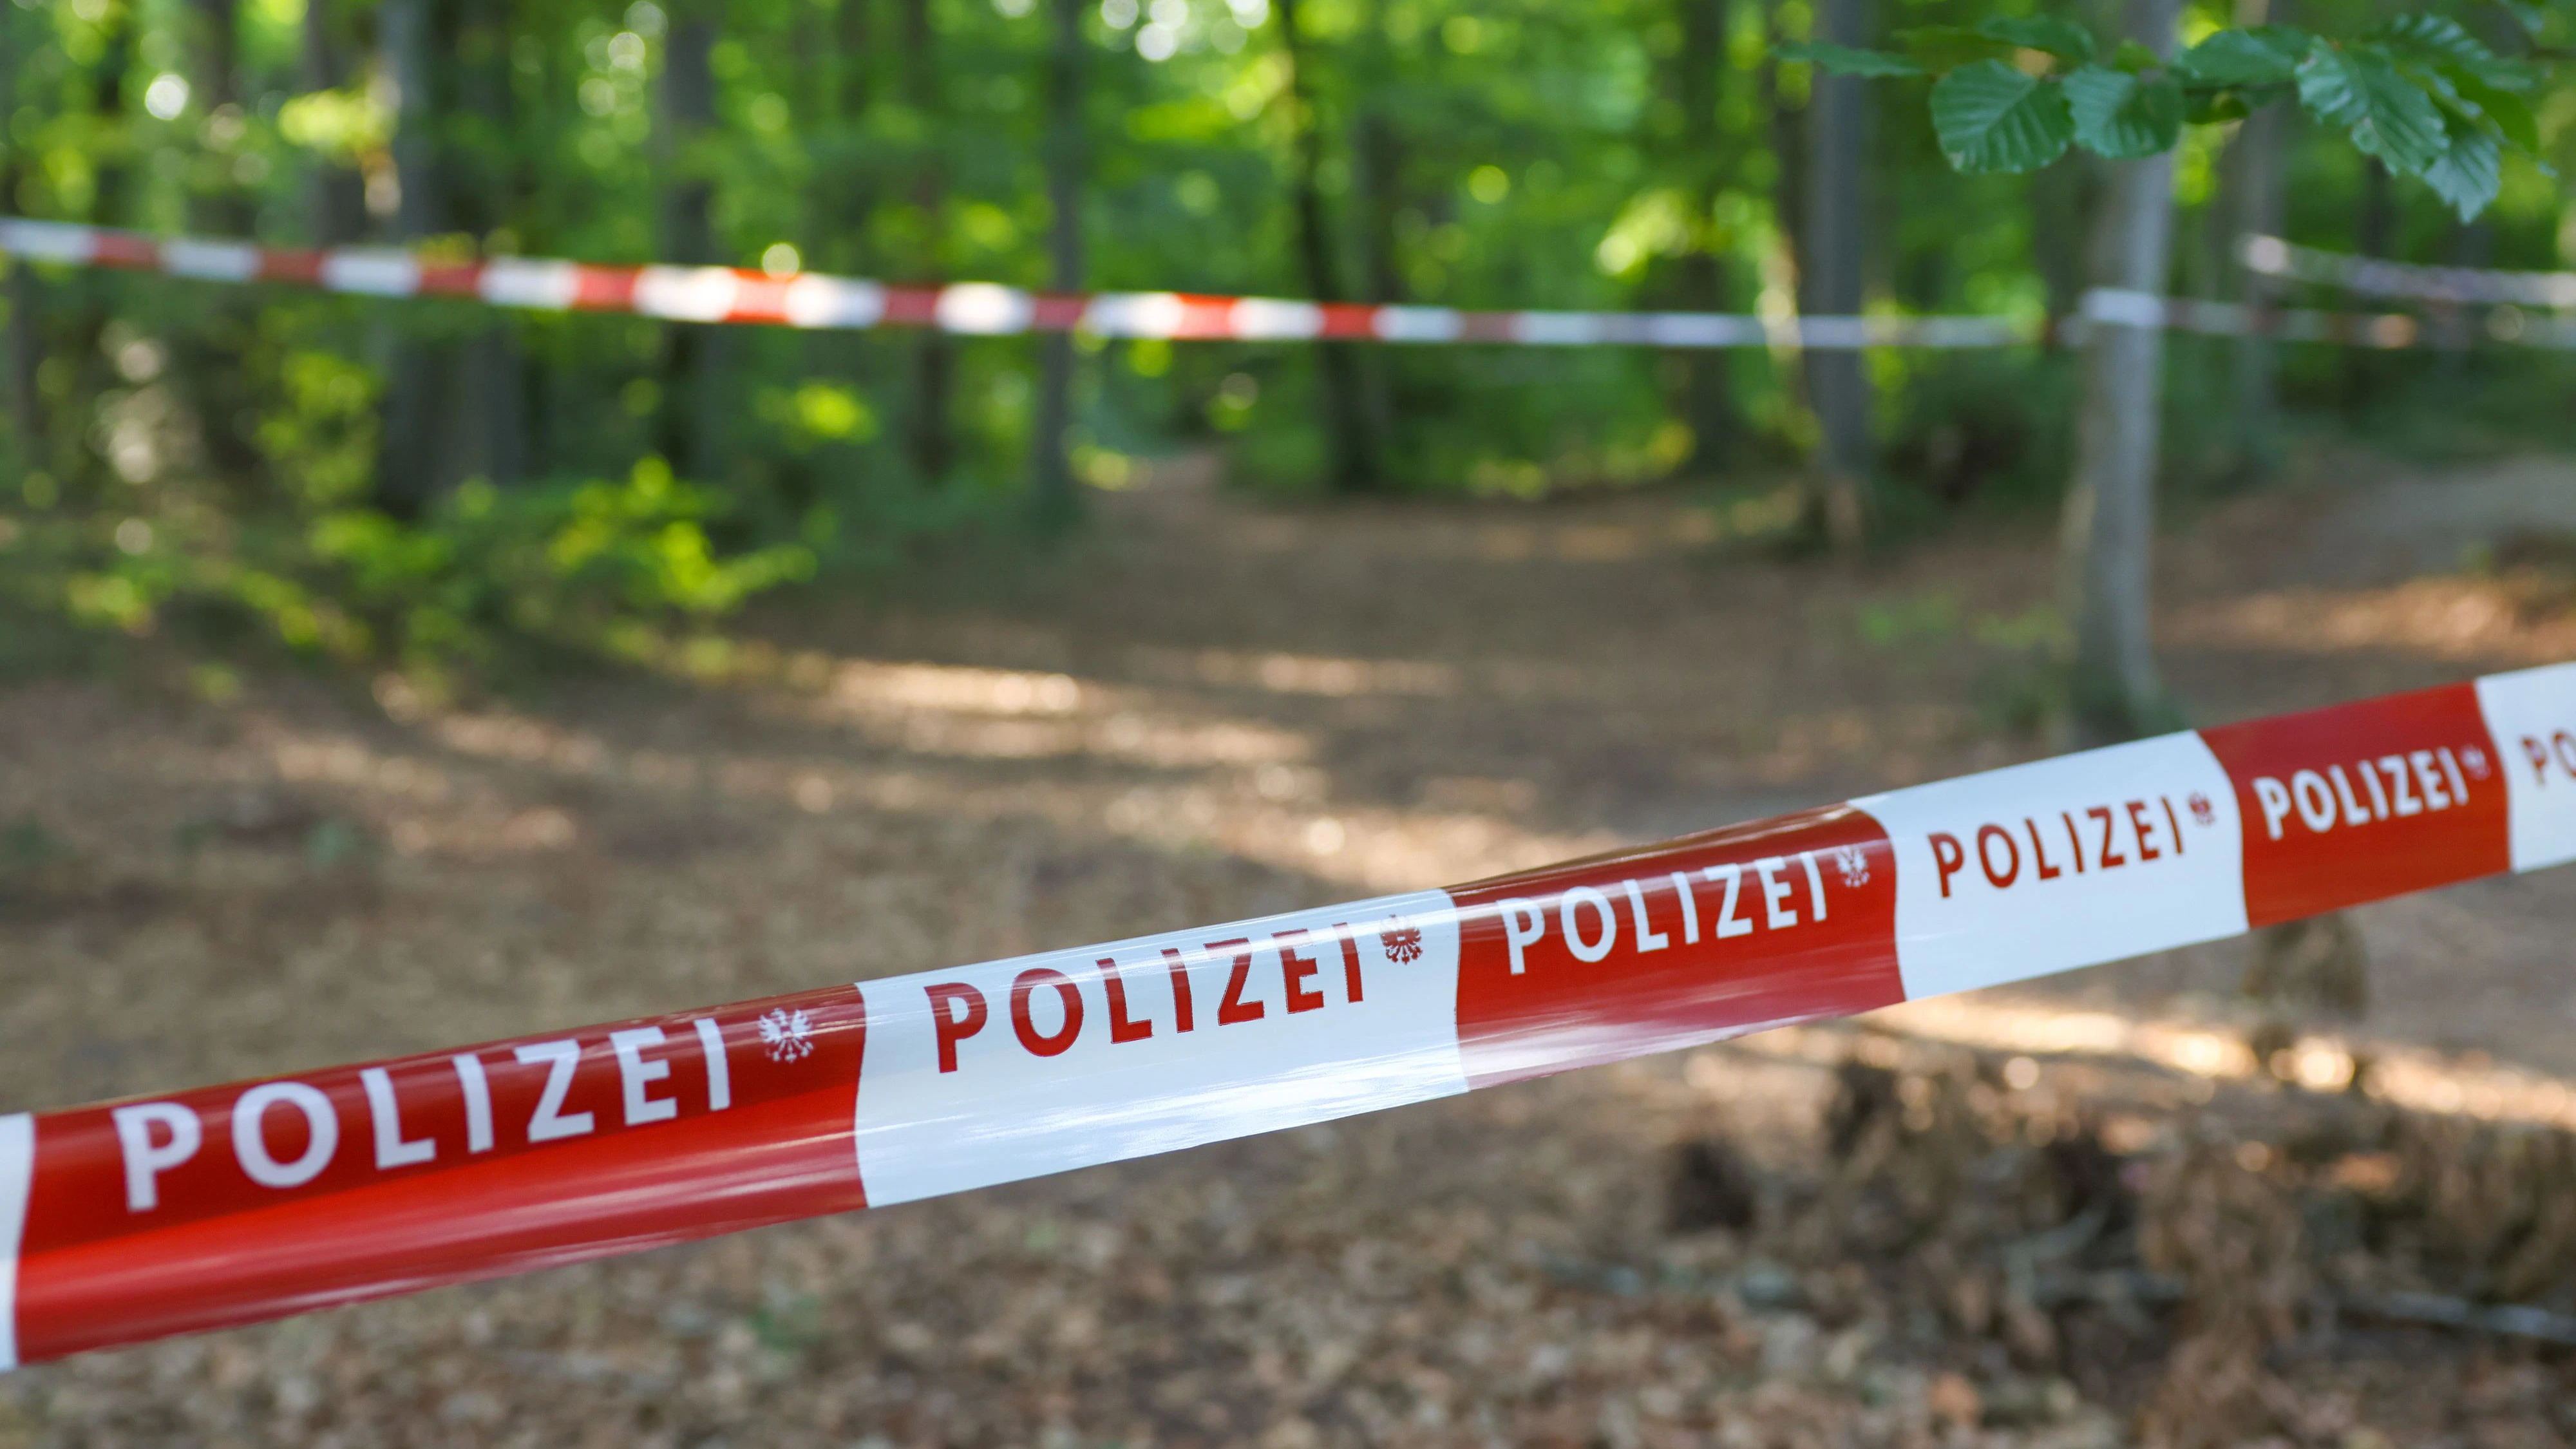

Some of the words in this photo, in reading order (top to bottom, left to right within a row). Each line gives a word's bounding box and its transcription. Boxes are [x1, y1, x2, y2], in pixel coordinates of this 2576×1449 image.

[111, 1018, 731, 1211] POLIZEI
[923, 922, 1363, 1073] POLIZEI
[1496, 851, 1827, 975] POLIZEI
[1928, 795, 2184, 898] POLIZEI
[2251, 746, 2469, 841] POLIZEI
